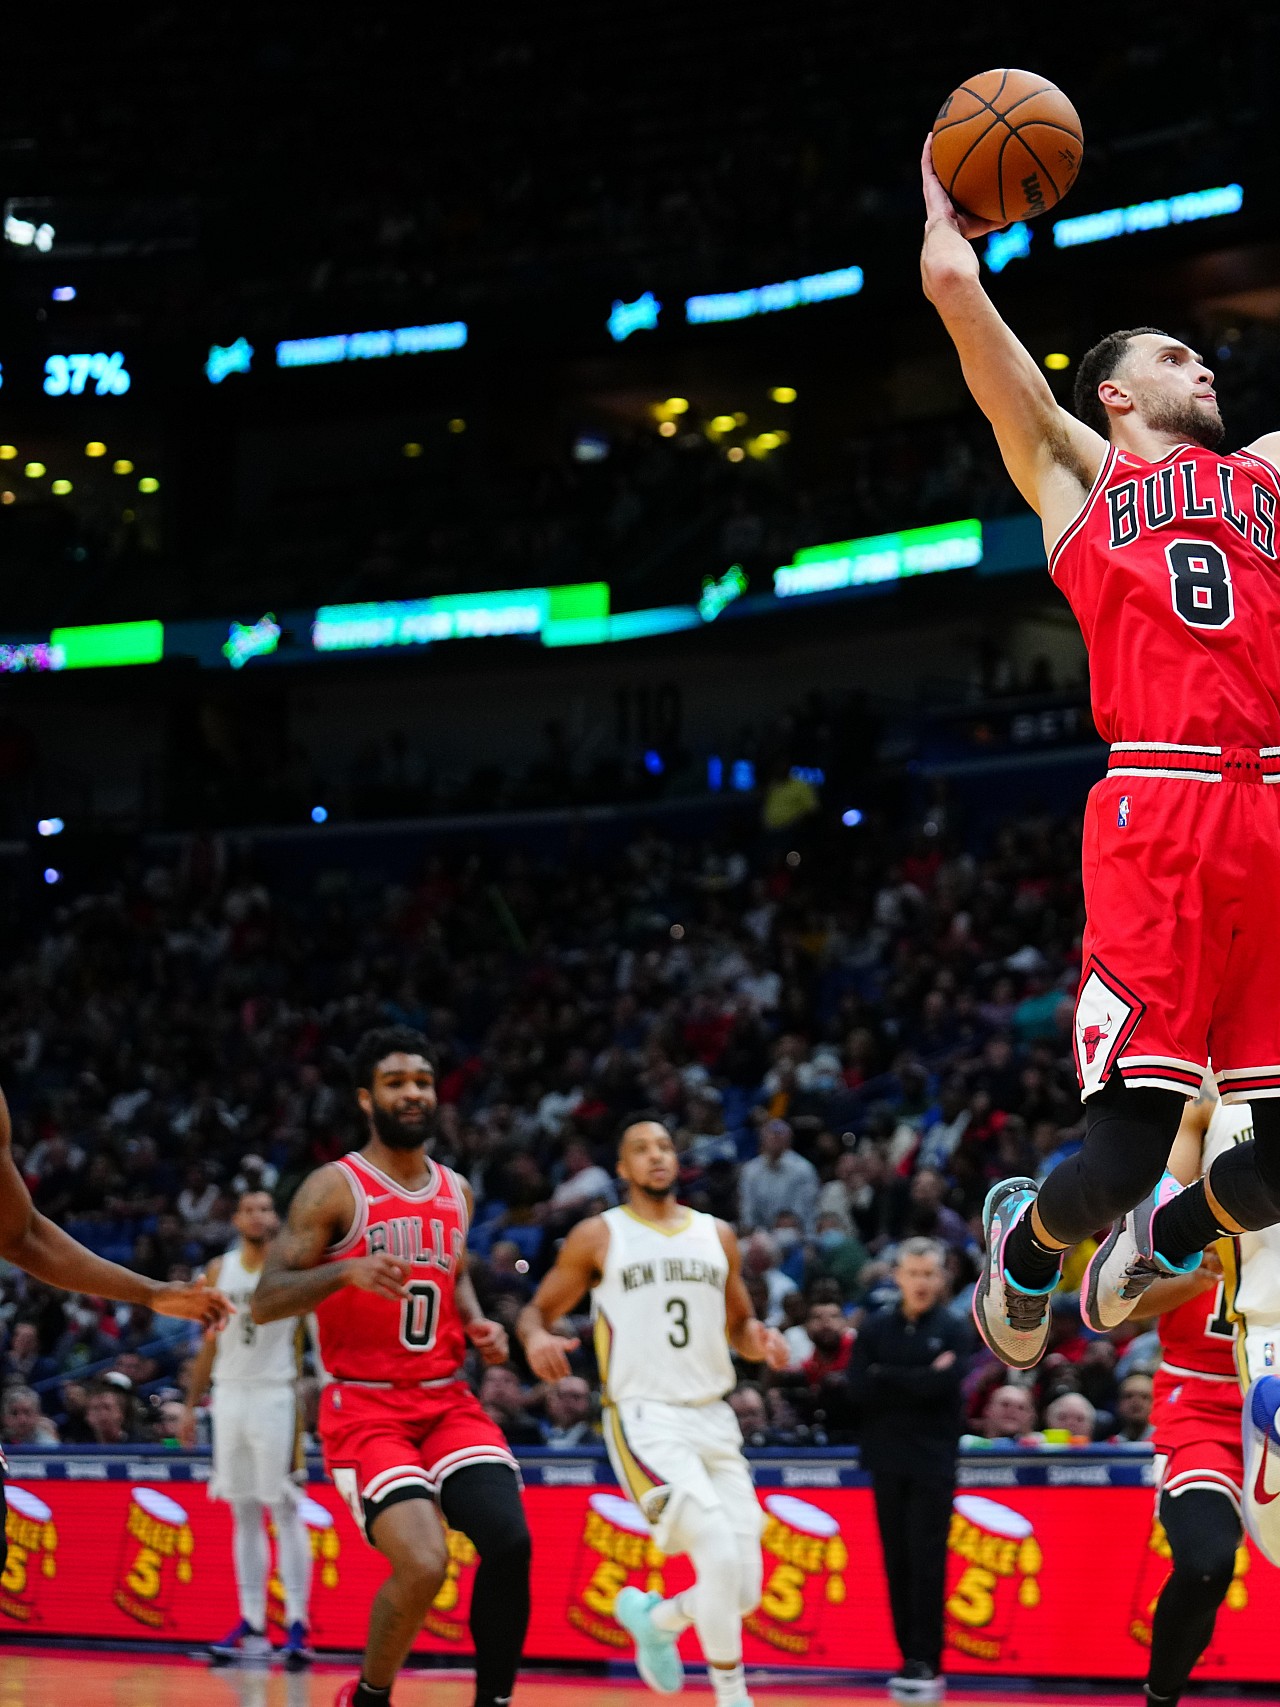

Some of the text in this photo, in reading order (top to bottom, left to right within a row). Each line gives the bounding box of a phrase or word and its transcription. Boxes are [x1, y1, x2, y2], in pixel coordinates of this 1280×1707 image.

[43, 351, 130, 396] 37%
[1105, 460, 1278, 560] BULLS
[1164, 538, 1235, 630] 8
[399, 1280, 441, 1352] 0
[665, 1297, 689, 1349] 3
[126, 1547, 162, 1599] 5
[582, 1560, 628, 1617] 5
[761, 1563, 805, 1622] 5
[945, 1566, 997, 1628] 5
